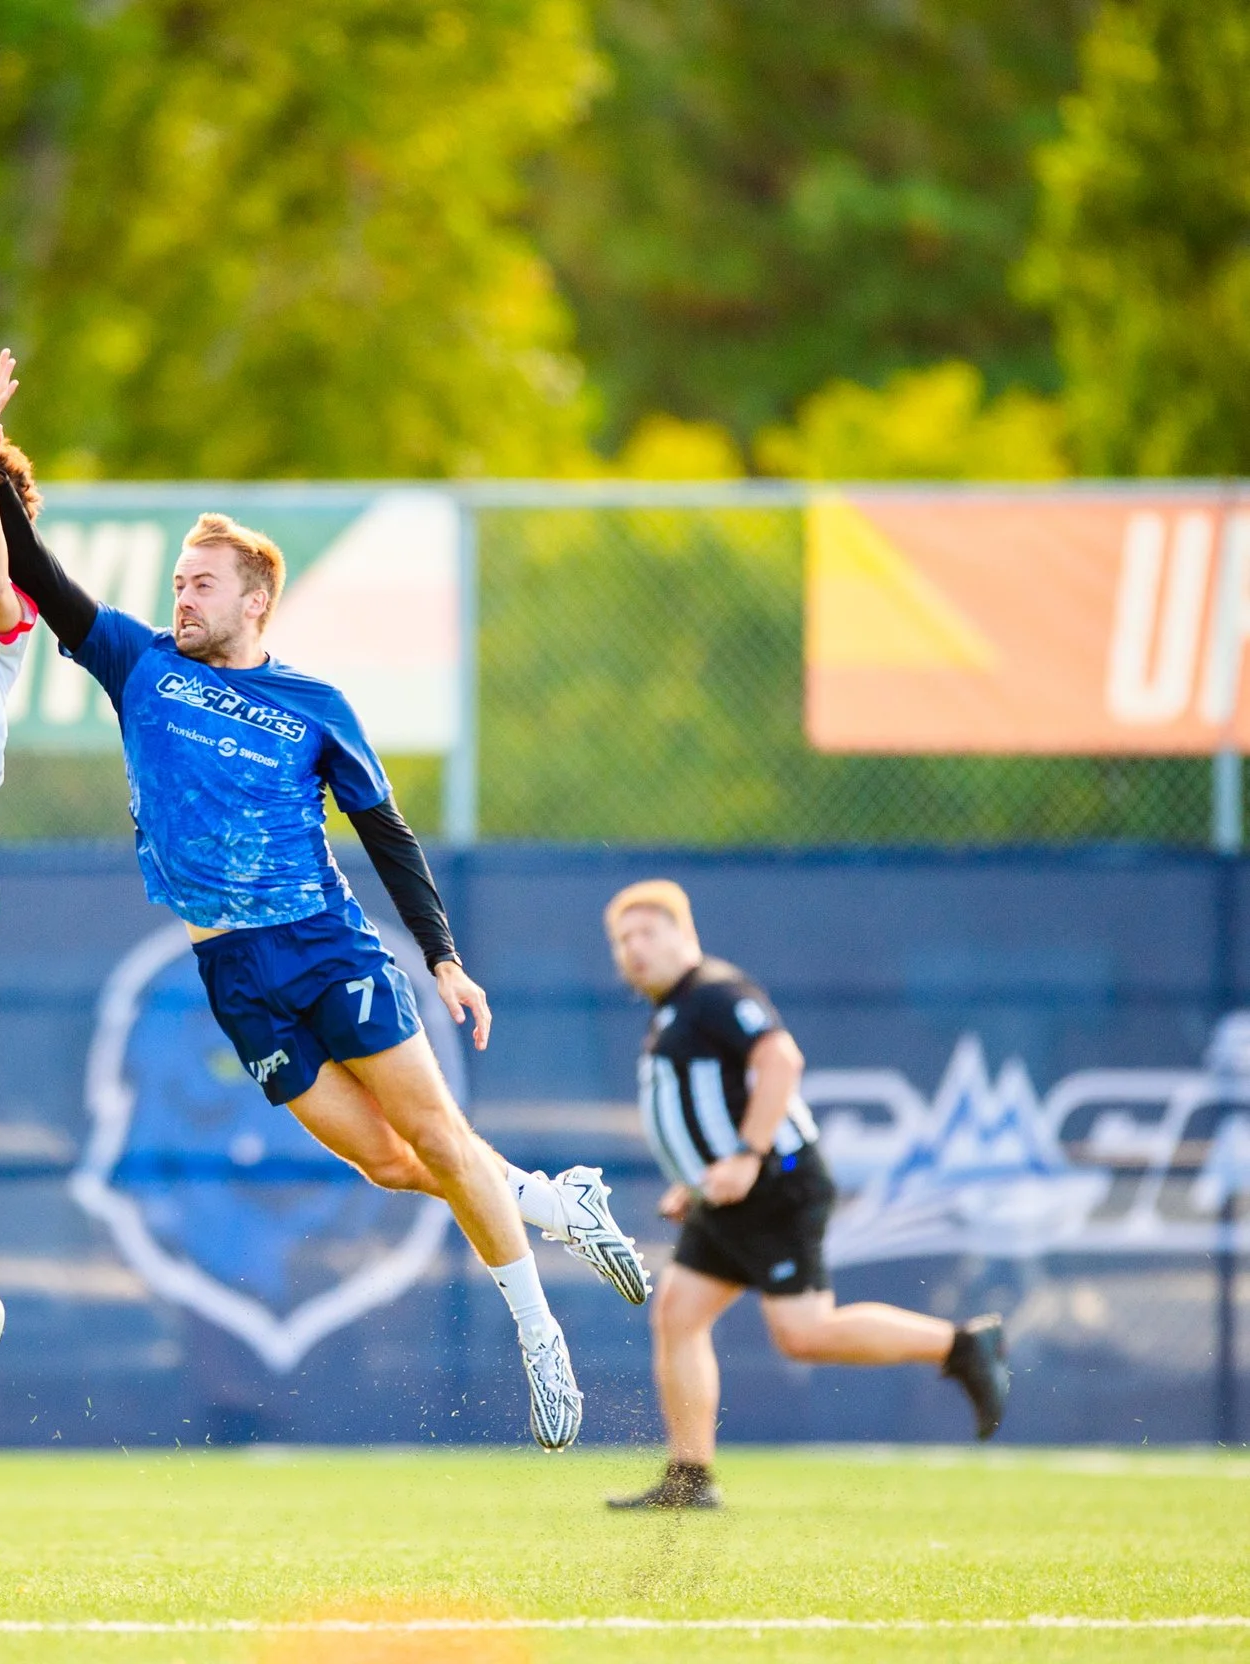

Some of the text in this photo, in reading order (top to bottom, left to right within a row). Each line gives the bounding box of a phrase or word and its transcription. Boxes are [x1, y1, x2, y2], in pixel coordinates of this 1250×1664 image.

[166, 721, 279, 769] Providence SWEDISH
[345, 975, 375, 1025] 7
